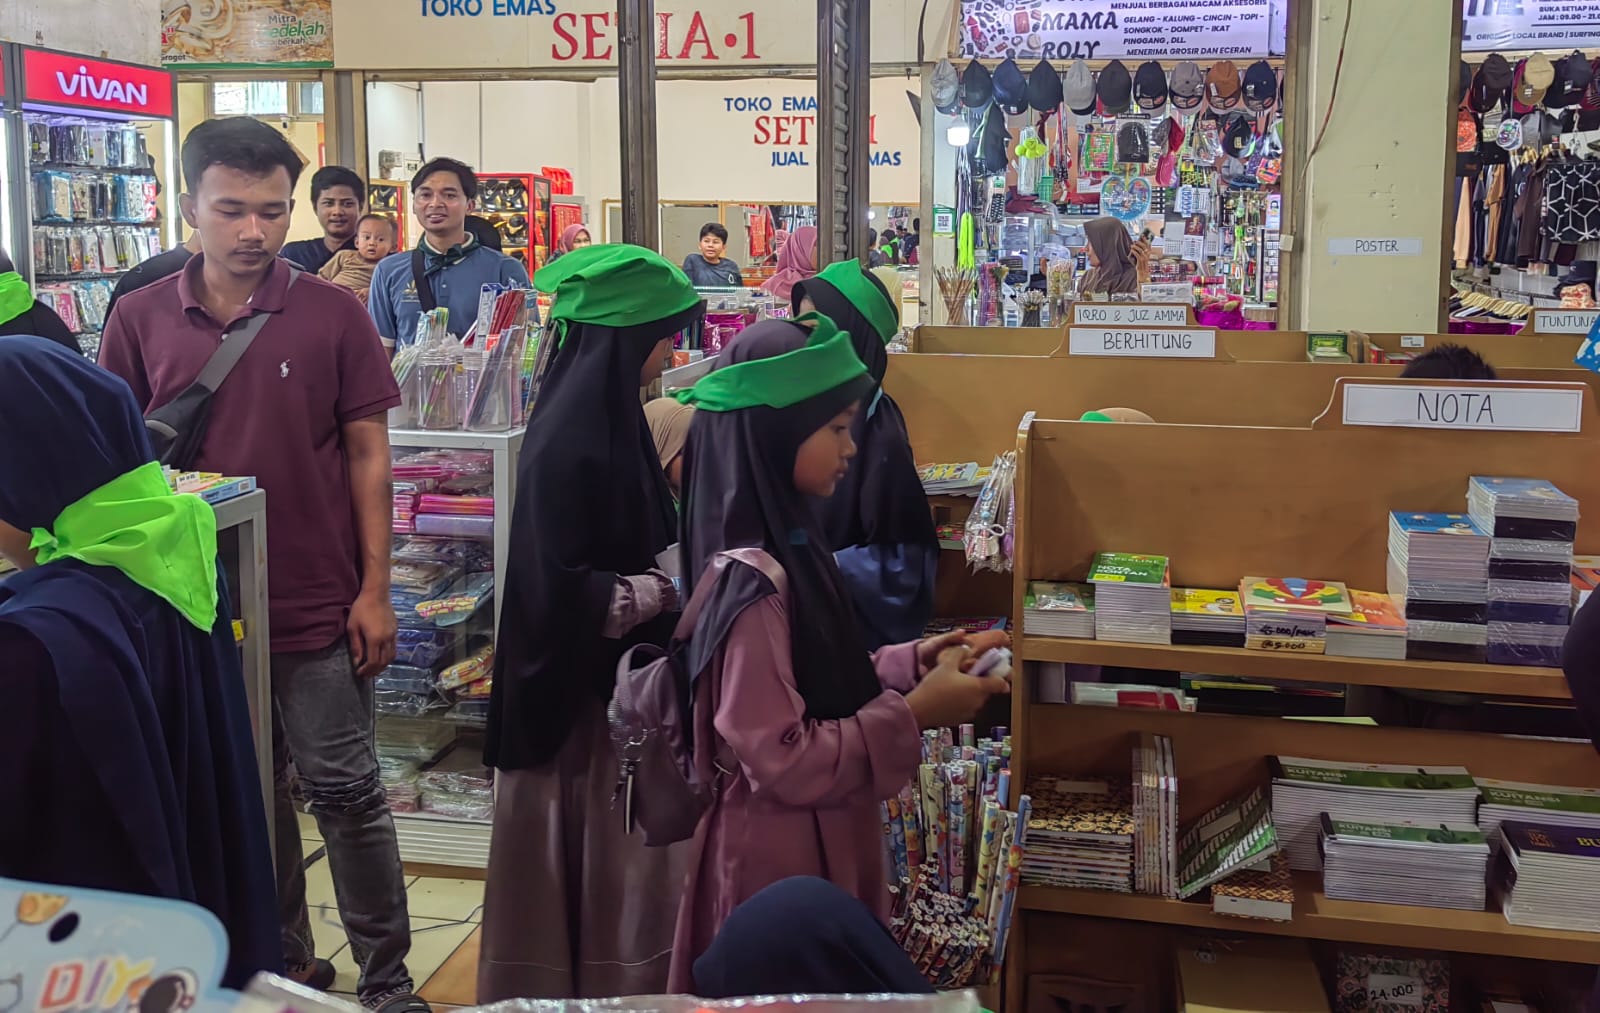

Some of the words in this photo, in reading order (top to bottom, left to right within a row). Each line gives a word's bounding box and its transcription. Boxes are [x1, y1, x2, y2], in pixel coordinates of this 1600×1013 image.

[421, 0, 482, 16] TOKO
[493, 0, 557, 16] EMAS
[268, 15, 297, 25] Mitra
[1041, 11, 1118, 31] MAMA
[262, 20, 327, 39] edekah
[1124, 26, 1163, 34] SONGKOK
[1170, 25, 1204, 33] DOMPET
[1537, 31, 1563, 39] BRAND
[1123, 37, 1166, 45] PINGGANG
[1041, 40, 1101, 60] ROLY
[1126, 48, 1168, 56] MENERIMA
[1169, 47, 1199, 55] GROSIR
[1200, 46, 1219, 54] DAN
[1220, 46, 1252, 54] ECERAN
[724, 97, 772, 111] TOKO
[782, 96, 818, 111] EMA
[771, 151, 809, 166] JUAL
[1355, 239, 1400, 253] POSTER
[1078, 308, 1107, 322] IQRO
[1113, 309, 1122, 322] &
[1127, 308, 1150, 323] JUZ
[1154, 309, 1185, 322] AMMA
[1103, 332, 1193, 350] BERHITUNG
[1417, 391, 1494, 424] NOTA
[1097, 564, 1132, 572] NOTA
[39, 956, 155, 1010] DIY
